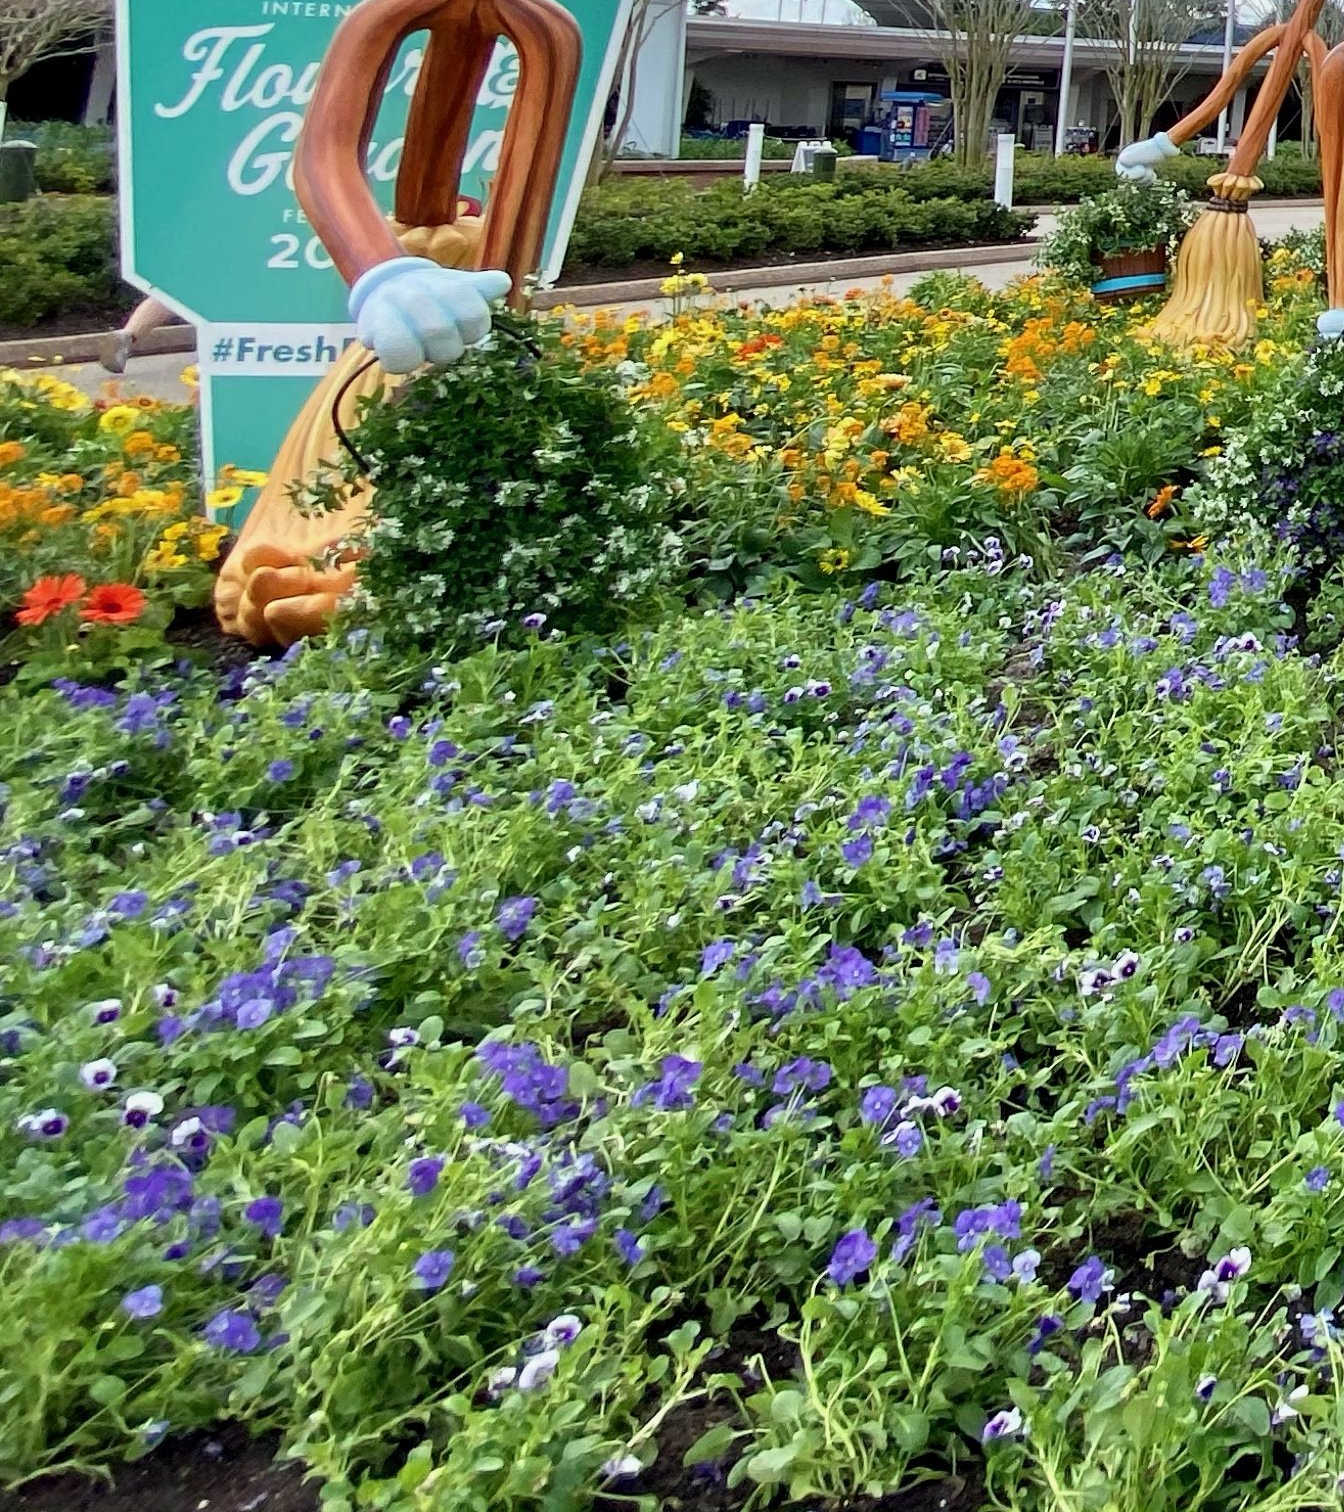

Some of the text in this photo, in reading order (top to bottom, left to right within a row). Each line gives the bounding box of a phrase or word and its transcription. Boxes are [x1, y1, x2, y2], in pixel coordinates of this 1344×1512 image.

[262, 1, 349, 18] INTERN
[266, 233, 335, 270] 20
[212, 335, 357, 363] #Fresh
